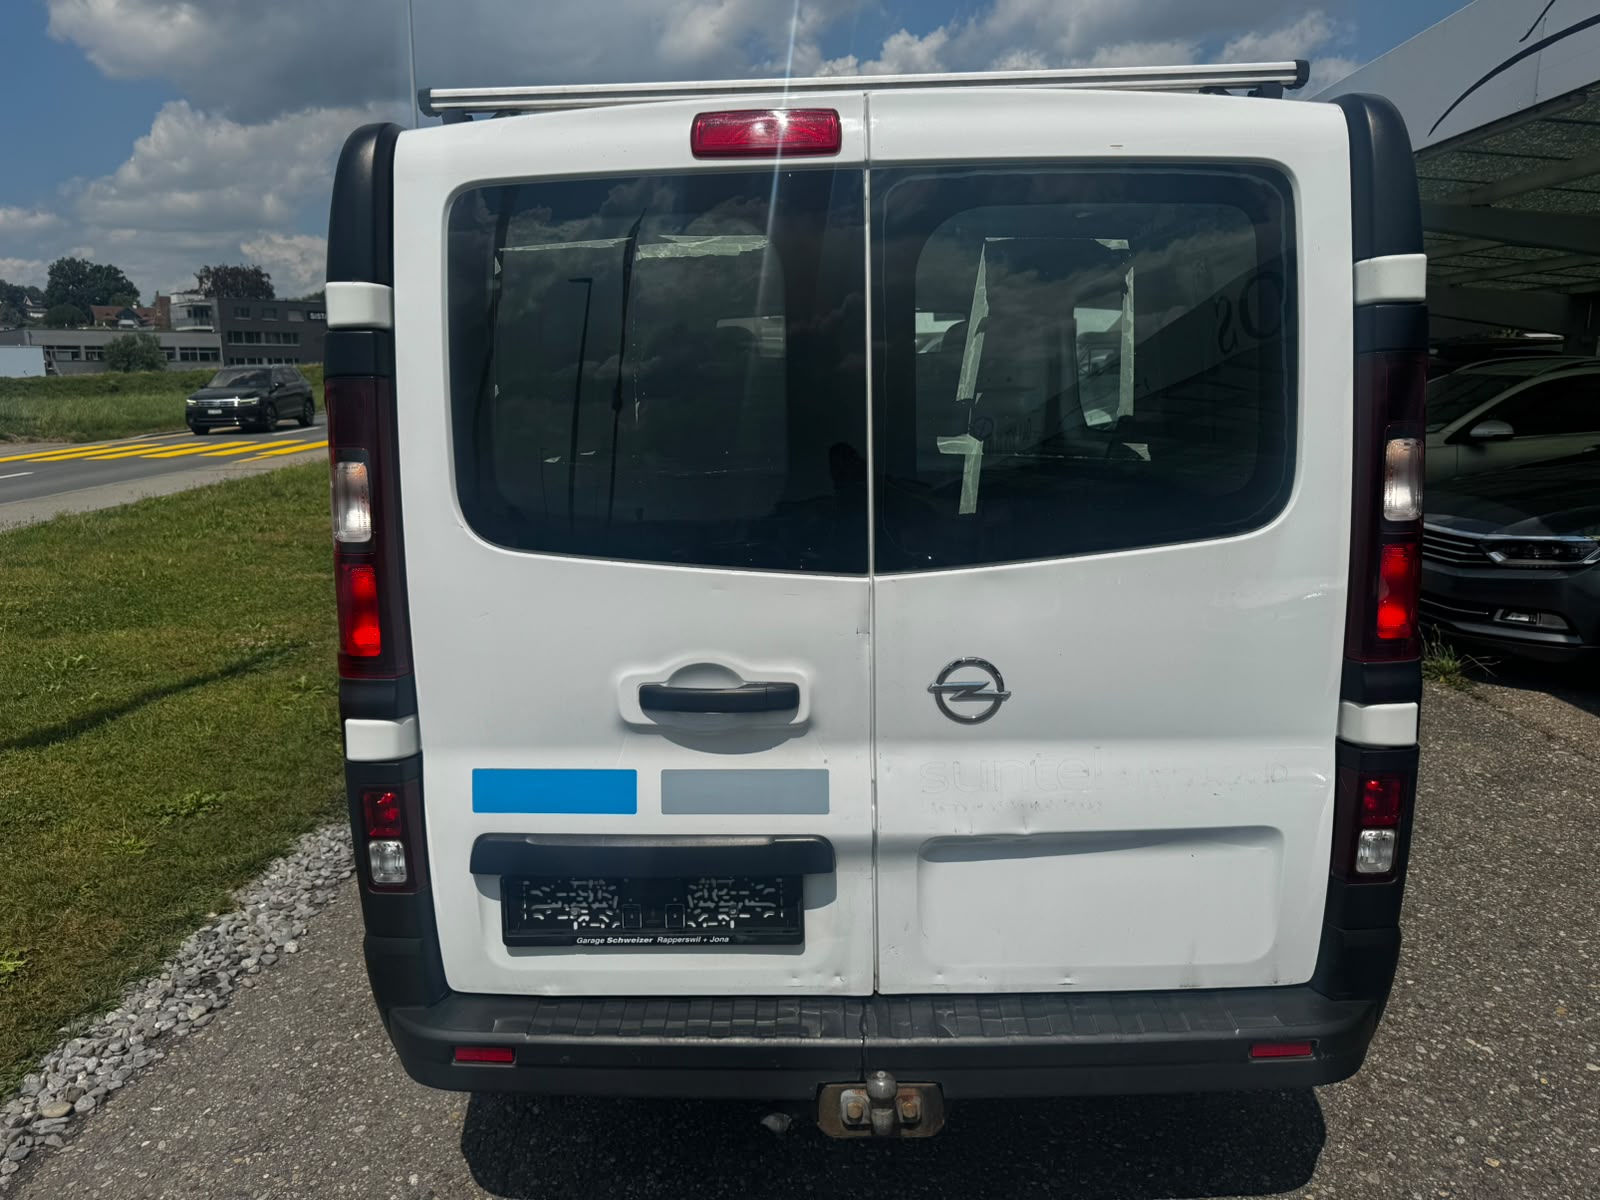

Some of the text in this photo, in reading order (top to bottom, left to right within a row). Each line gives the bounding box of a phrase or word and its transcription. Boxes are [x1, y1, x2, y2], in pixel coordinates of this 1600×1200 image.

[919, 746, 1104, 794] suntel
[576, 937, 605, 945] Garage
[657, 936, 702, 944] Rapperswil
